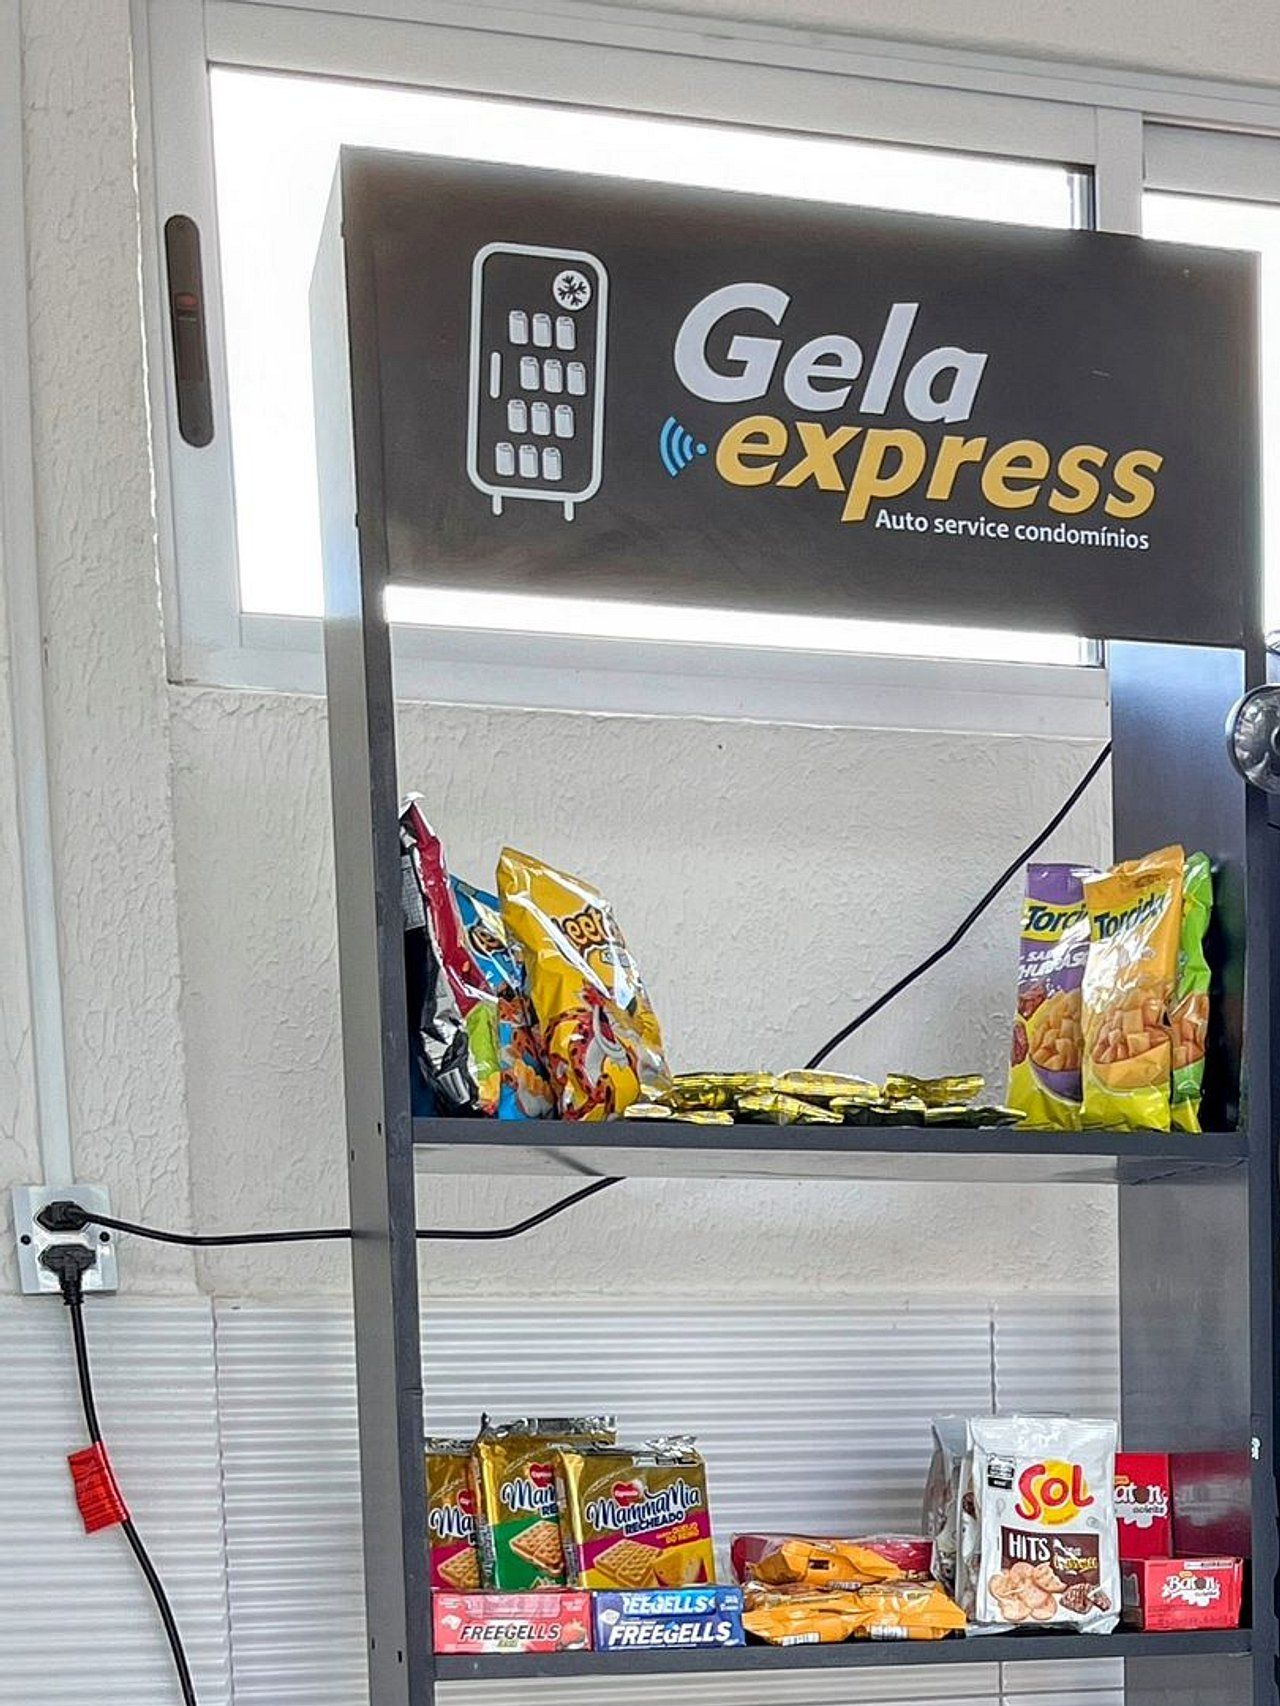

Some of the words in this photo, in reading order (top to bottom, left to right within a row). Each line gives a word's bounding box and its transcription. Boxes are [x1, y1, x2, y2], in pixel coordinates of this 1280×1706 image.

[673, 282, 988, 425] Gela
[715, 415, 1165, 523] express
[875, 508, 929, 533] Auto
[933, 515, 1010, 539] service
[1014, 522, 1150, 551] condomínios
[1023, 902, 1088, 932] Torci
[1114, 1481, 1164, 1504] aton
[624, 1510, 684, 1536] RECHEADO
[1008, 1531, 1051, 1562] HITS
[460, 1624, 561, 1641] FREEGELLS
[608, 1620, 733, 1646] FREEGELLS
